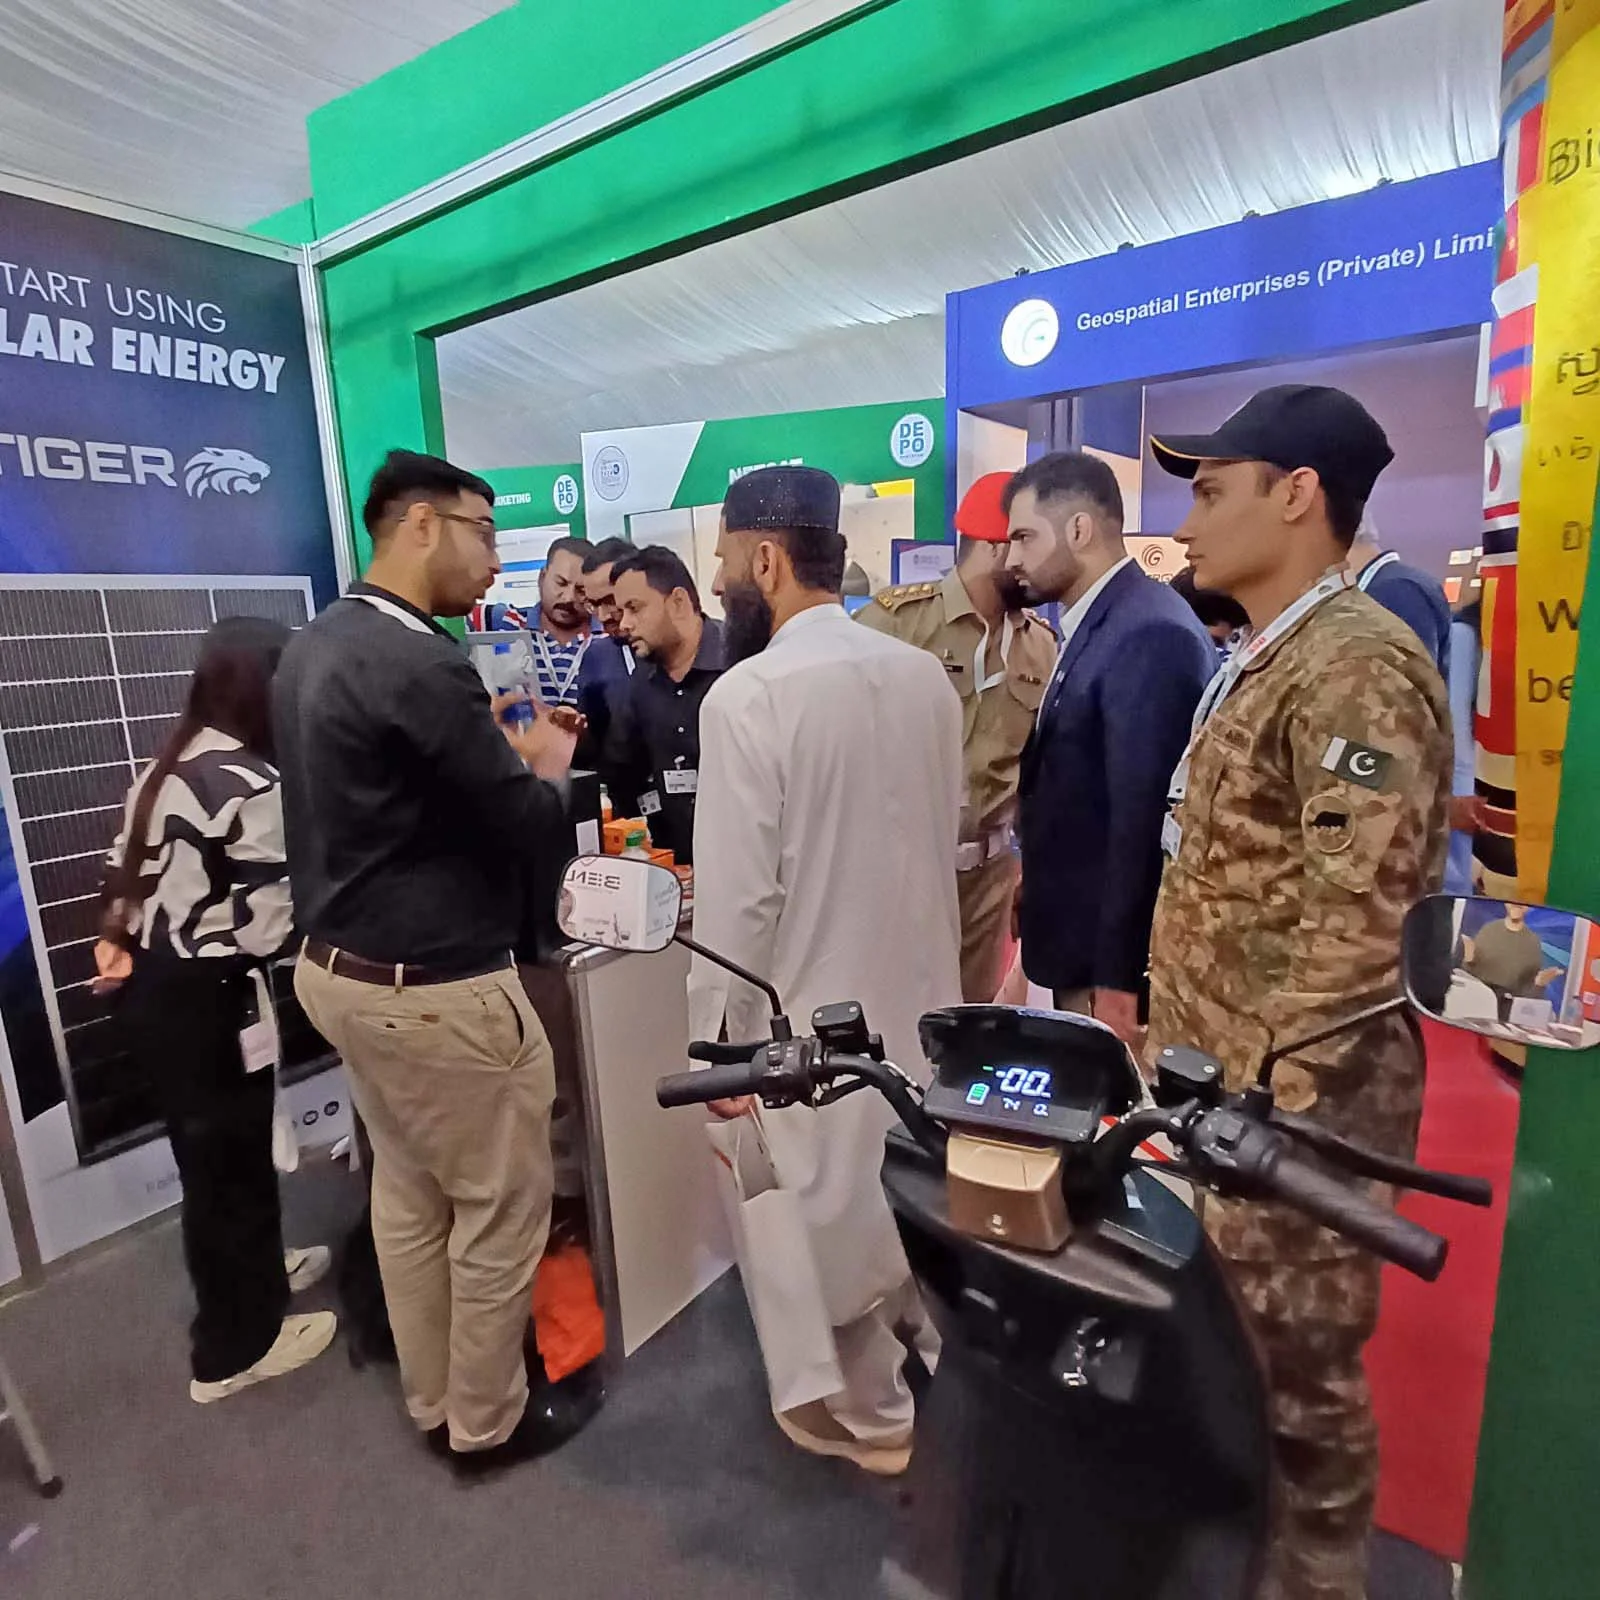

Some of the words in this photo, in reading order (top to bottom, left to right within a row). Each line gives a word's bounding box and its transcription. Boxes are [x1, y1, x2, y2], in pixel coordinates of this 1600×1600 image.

[0, 261, 91, 308] TART
[105, 283, 226, 333] USING
[1077, 294, 1178, 331] Geospatial
[1185, 269, 1310, 309] Enterprises
[1317, 241, 1425, 287] (Private)
[112, 327, 286, 393] ENERGY
